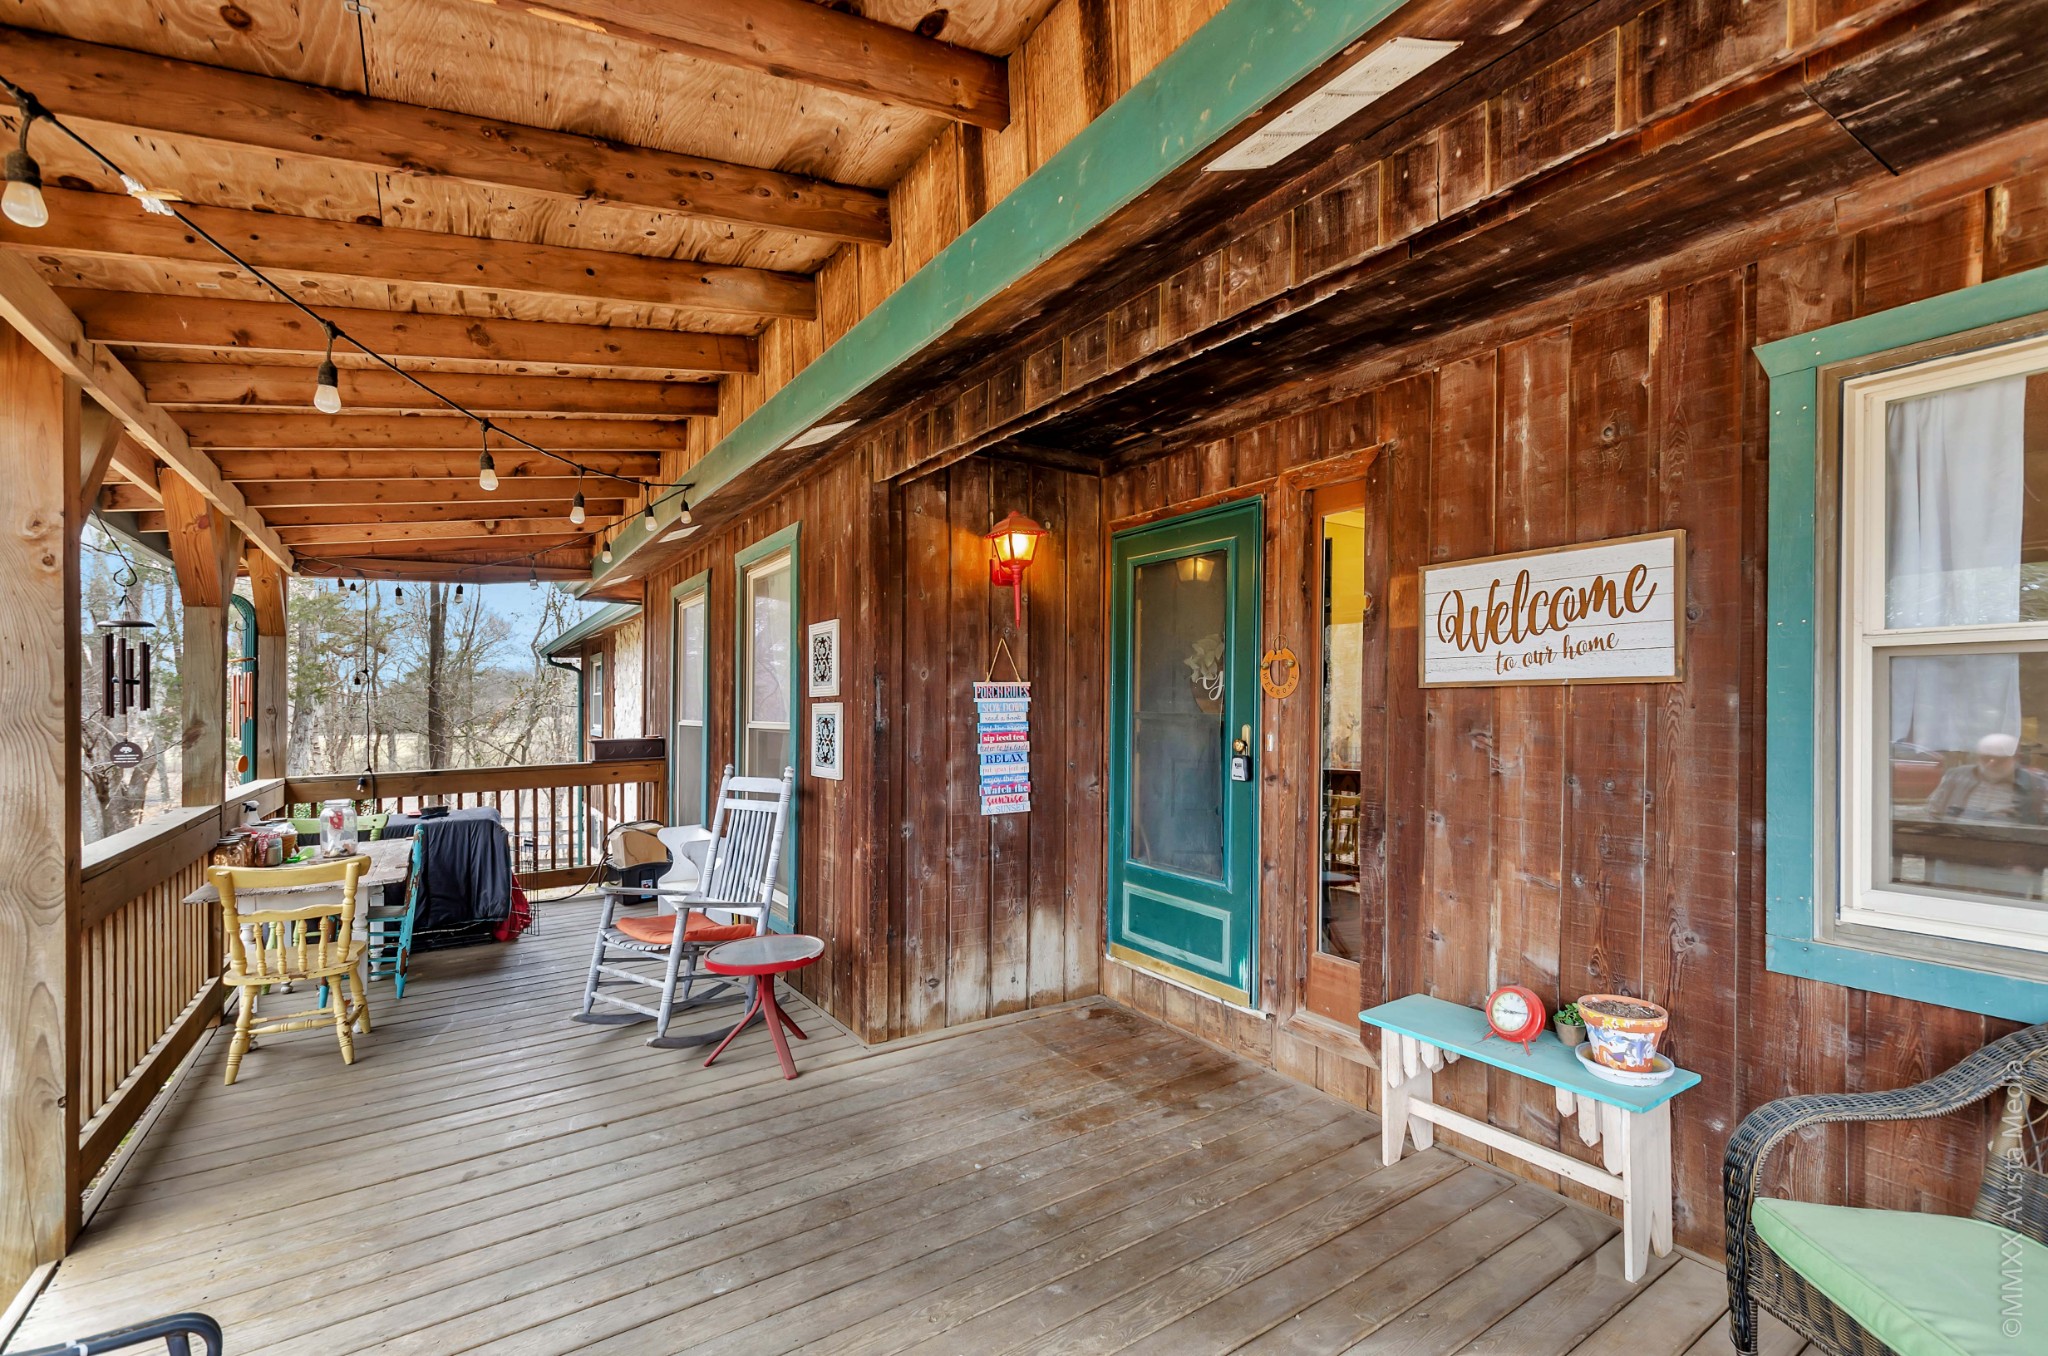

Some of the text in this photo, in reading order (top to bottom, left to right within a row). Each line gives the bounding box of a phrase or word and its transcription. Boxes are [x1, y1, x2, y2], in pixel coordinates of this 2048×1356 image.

[1437, 563, 1658, 653] Welcome
[1496, 632, 1620, 675] to our home
[976, 685, 1030, 698] PORCH RULES
[983, 733, 1025, 744] sip iced tea
[986, 753, 1024, 764] RELAX
[983, 784, 1029, 795] Watch the
[995, 804, 1026, 813] SUNSET
